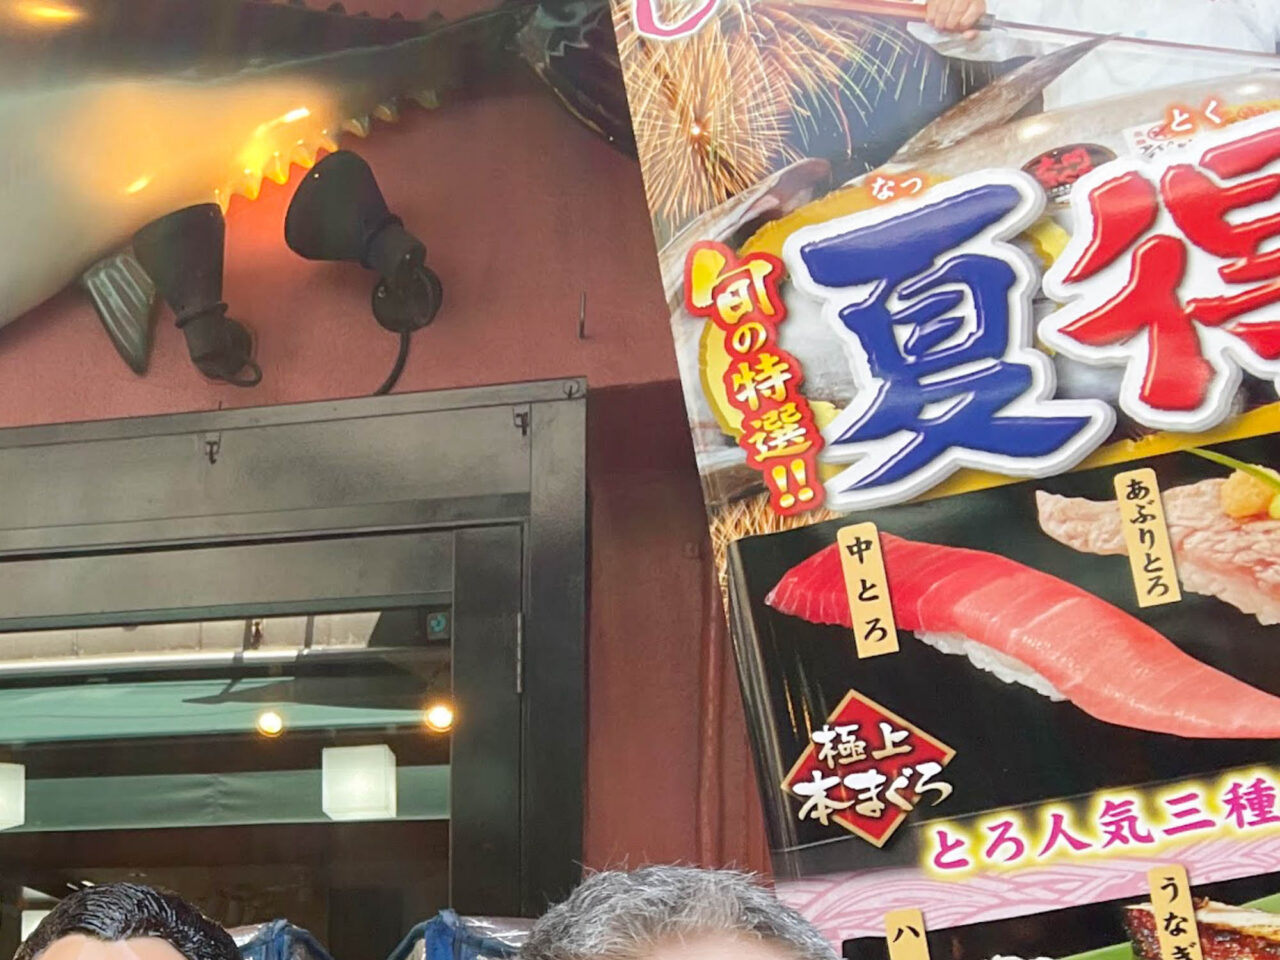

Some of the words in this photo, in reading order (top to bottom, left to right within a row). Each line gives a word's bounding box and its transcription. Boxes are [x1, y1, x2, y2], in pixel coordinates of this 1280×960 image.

[1171, 99, 1221, 132] とく
[872, 176, 923, 201] なつ
[1126, 478, 1170, 598] あぶりとろ
[846, 536, 888, 643] 中とろ
[812, 722, 913, 769] 極上
[792, 761, 954, 826] 本まぐろ
[932, 777, 1280, 870] とろ人気三種
